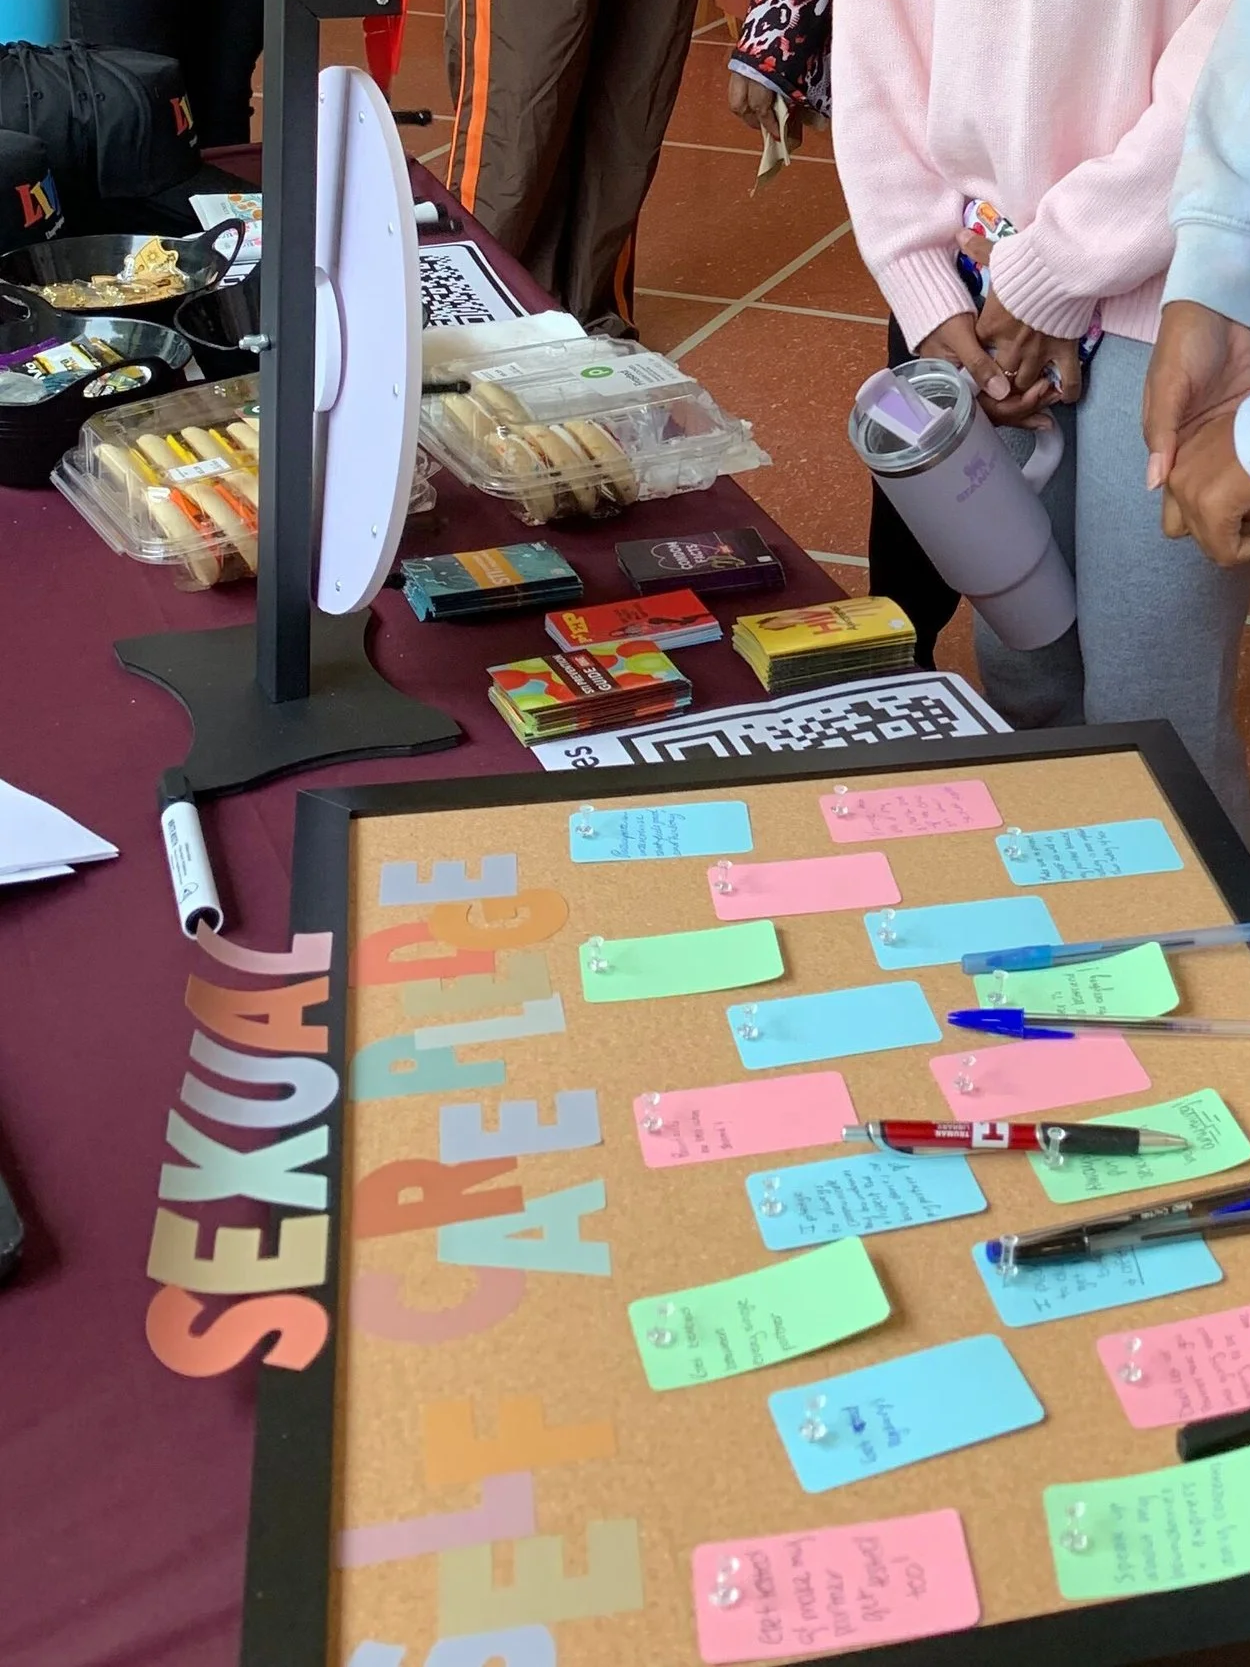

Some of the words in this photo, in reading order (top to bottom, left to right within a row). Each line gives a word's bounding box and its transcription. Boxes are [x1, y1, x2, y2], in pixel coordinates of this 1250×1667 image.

[665, 540, 695, 570] CONDOM
[685, 543, 709, 564] FACTS
[551, 654, 587, 687] PREVENTION
[582, 666, 612, 692] GUIDE
[577, 685, 594, 695] STI
[348, 853, 569, 1103] PLEDGE
[145, 918, 341, 1378] SEXUAL
[934, 1129, 970, 1138] TRUMAN
[348, 1088, 612, 1345] CARE
[790, 1571, 819, 1622] make
[856, 1586, 892, 1623] get
[756, 1605, 784, 1646] Get
